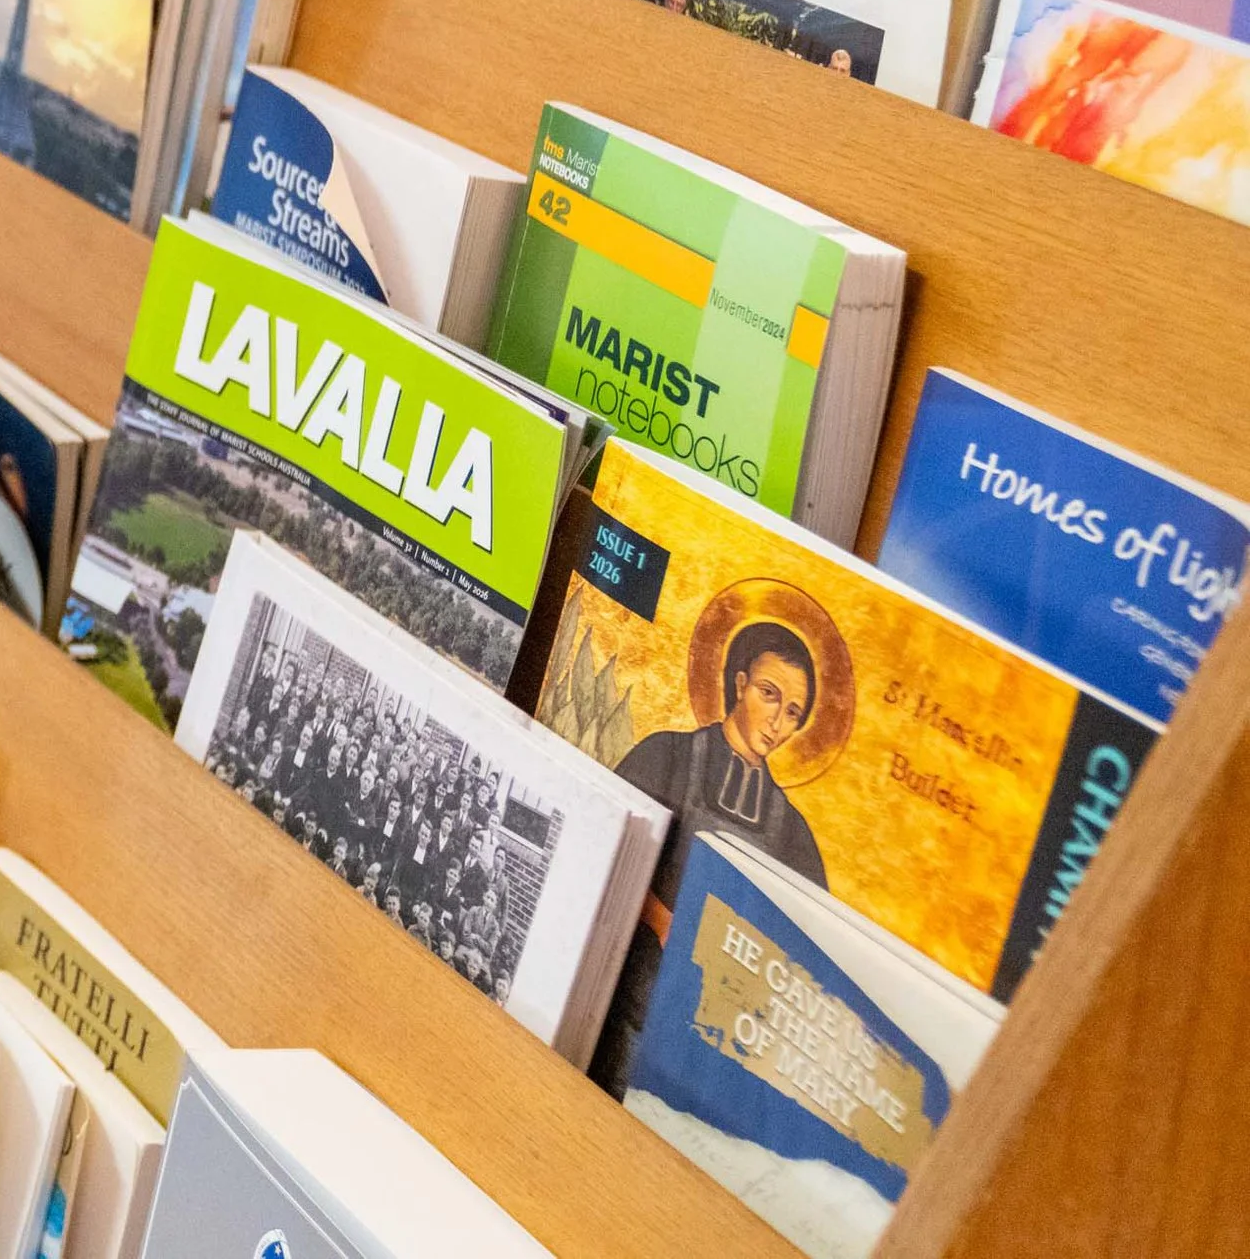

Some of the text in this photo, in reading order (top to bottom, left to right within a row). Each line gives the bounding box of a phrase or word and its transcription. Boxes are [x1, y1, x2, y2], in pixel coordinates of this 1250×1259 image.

[539, 153, 590, 189] NOTEBOOKS
[543, 134, 564, 159] fms
[268, 188, 350, 268] Streams
[539, 189, 571, 226] 42
[564, 306, 720, 418] MARIST
[174, 281, 493, 554] LAVALLA
[221, 431, 249, 452] MARIST
[248, 442, 278, 469] SCHOOLS
[278, 459, 312, 487] AUSTRALIA
[575, 365, 760, 498] notebooks
[596, 525, 646, 570] ISSUE 1
[959, 442, 1108, 545] Homes
[1113, 523, 1177, 588] of
[382, 526, 404, 548] Volume
[421, 550, 446, 573] Number
[458, 573, 472, 592] May
[472, 585, 489, 600] 2026
[589, 550, 621, 584] 2026
[15, 916, 150, 1064] FRATELLI
[721, 924, 764, 975] HE
[765, 958, 840, 1032] GAVE
[734, 1012, 861, 1128] OF MARY
[770, 995, 908, 1134] THE NAME
